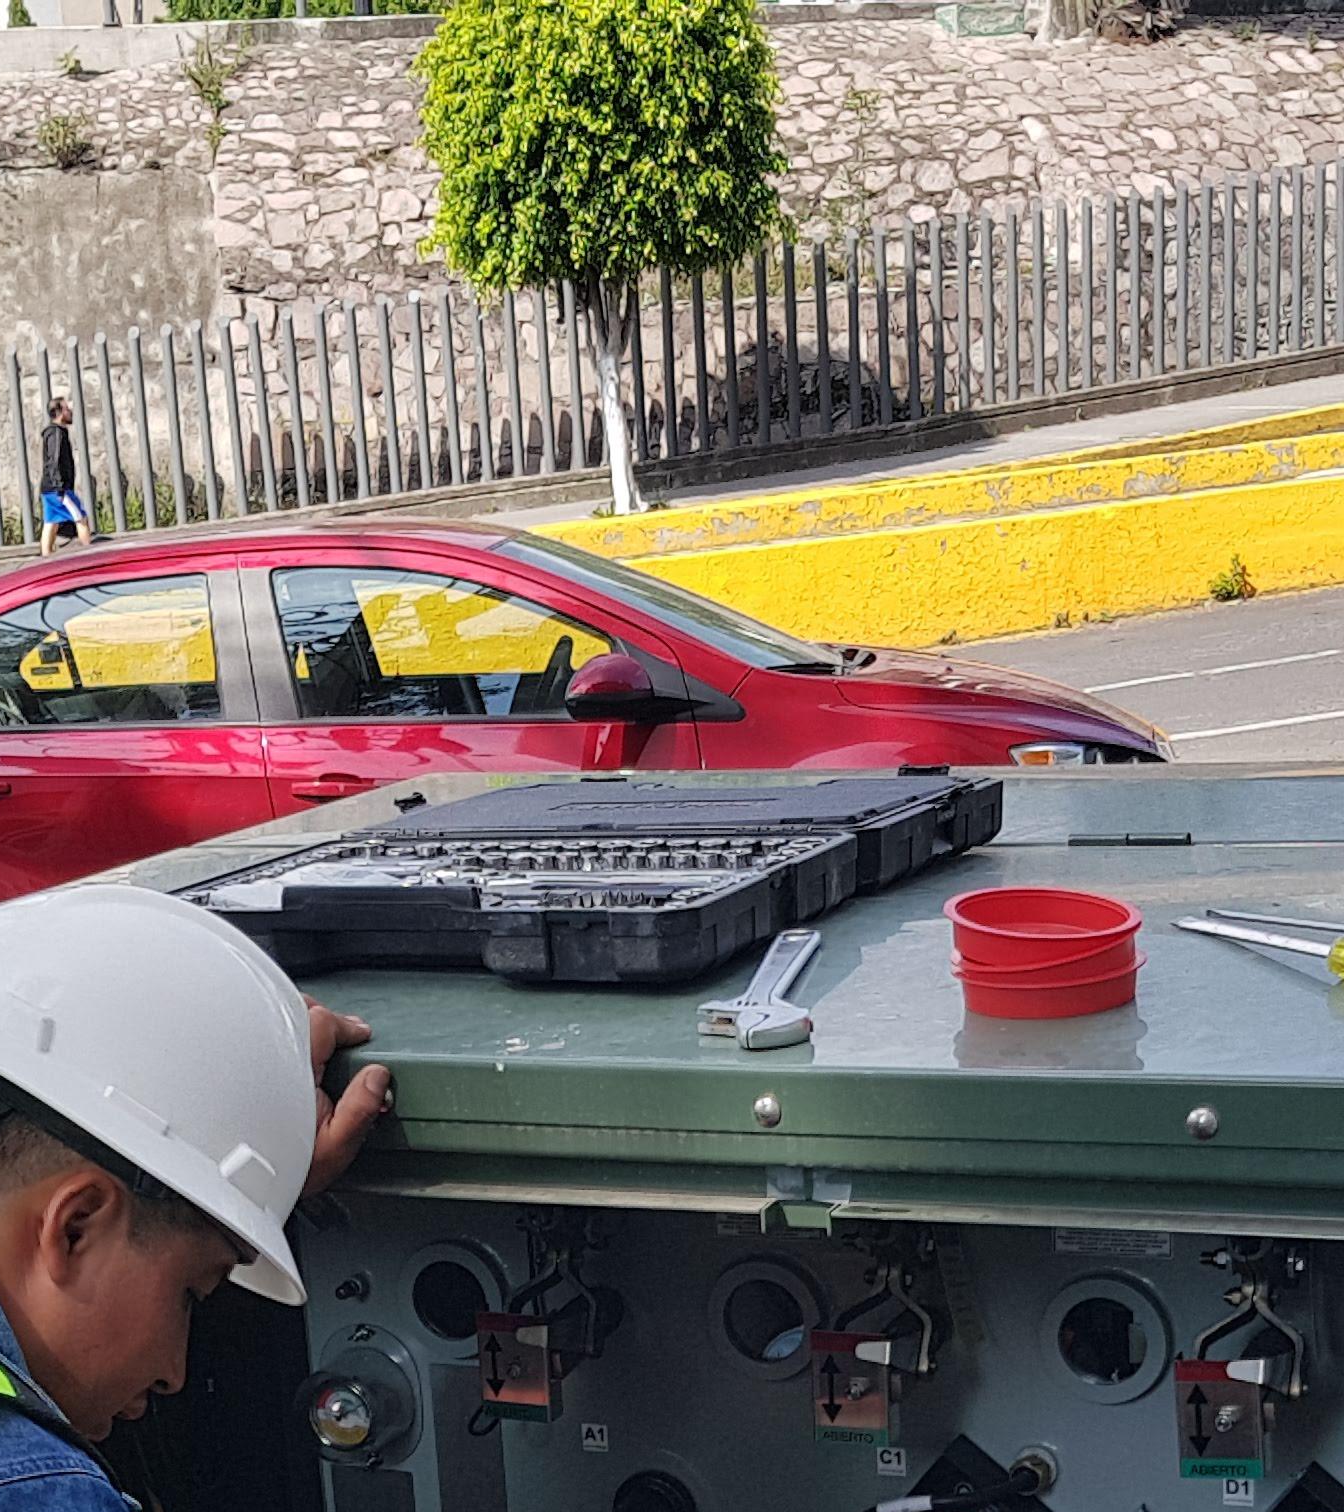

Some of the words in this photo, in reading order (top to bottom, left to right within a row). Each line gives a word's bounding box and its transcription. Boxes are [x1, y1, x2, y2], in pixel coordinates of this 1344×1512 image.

[584, 1427, 604, 1442] A1
[879, 1449, 902, 1466] C1
[1190, 1463, 1247, 1477] ABIERTO
[1225, 1479, 1249, 1496] D1
